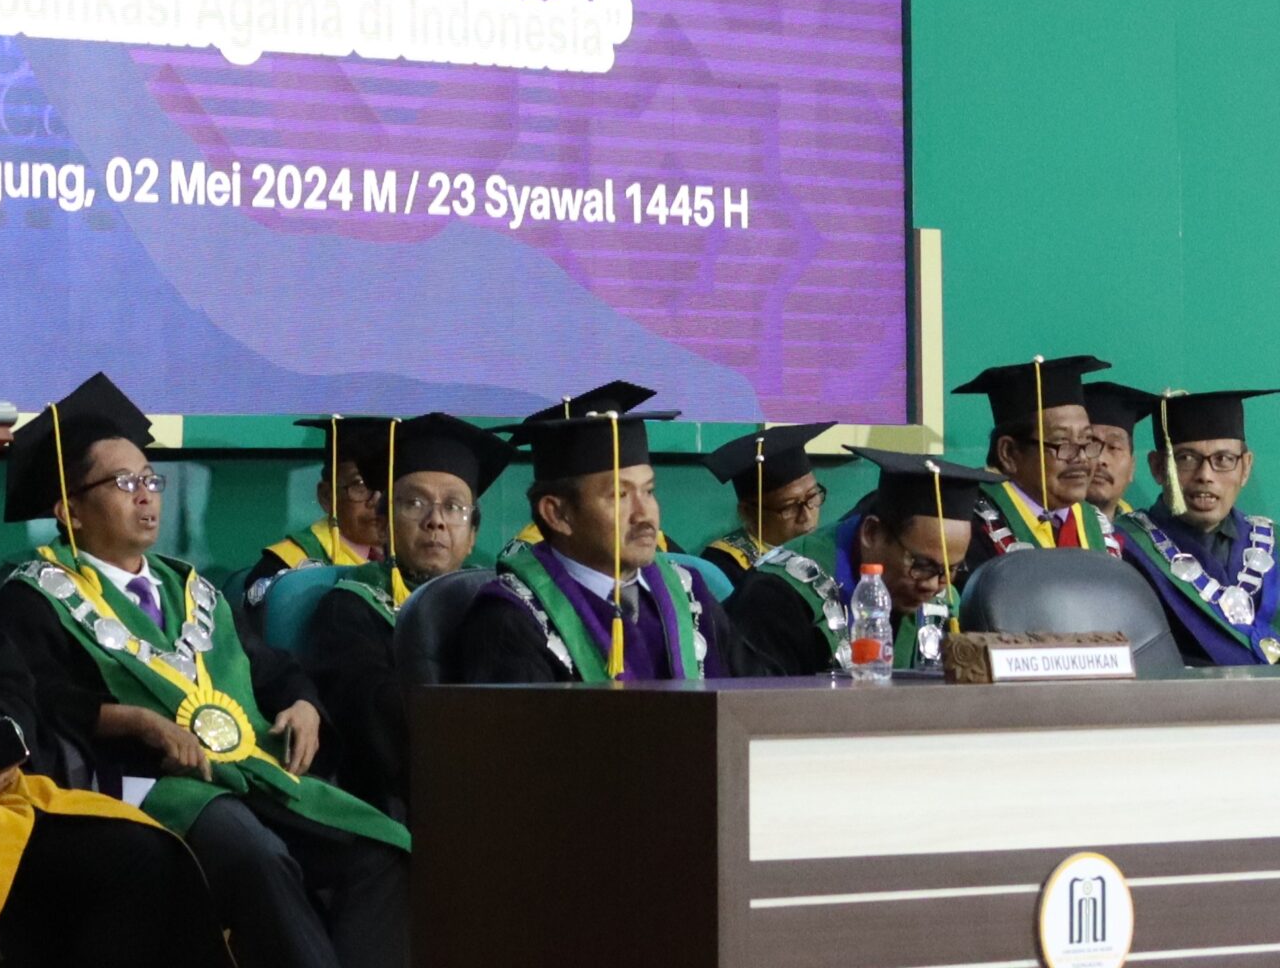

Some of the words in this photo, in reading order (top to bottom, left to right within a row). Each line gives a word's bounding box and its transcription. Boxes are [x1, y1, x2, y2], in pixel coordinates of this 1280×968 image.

[105, 156, 159, 204] 02
[170, 160, 241, 207] Mei
[251, 163, 353, 211] 2024
[363, 169, 397, 213] M
[404, 170, 419, 214] /
[427, 172, 476, 216] 23
[484, 174, 616, 229] Syawal
[625, 183, 715, 227] 1445
[724, 187, 749, 229] H
[1005, 656, 1040, 673] YANG
[1043, 653, 1119, 672] DIKUKUHKAN
